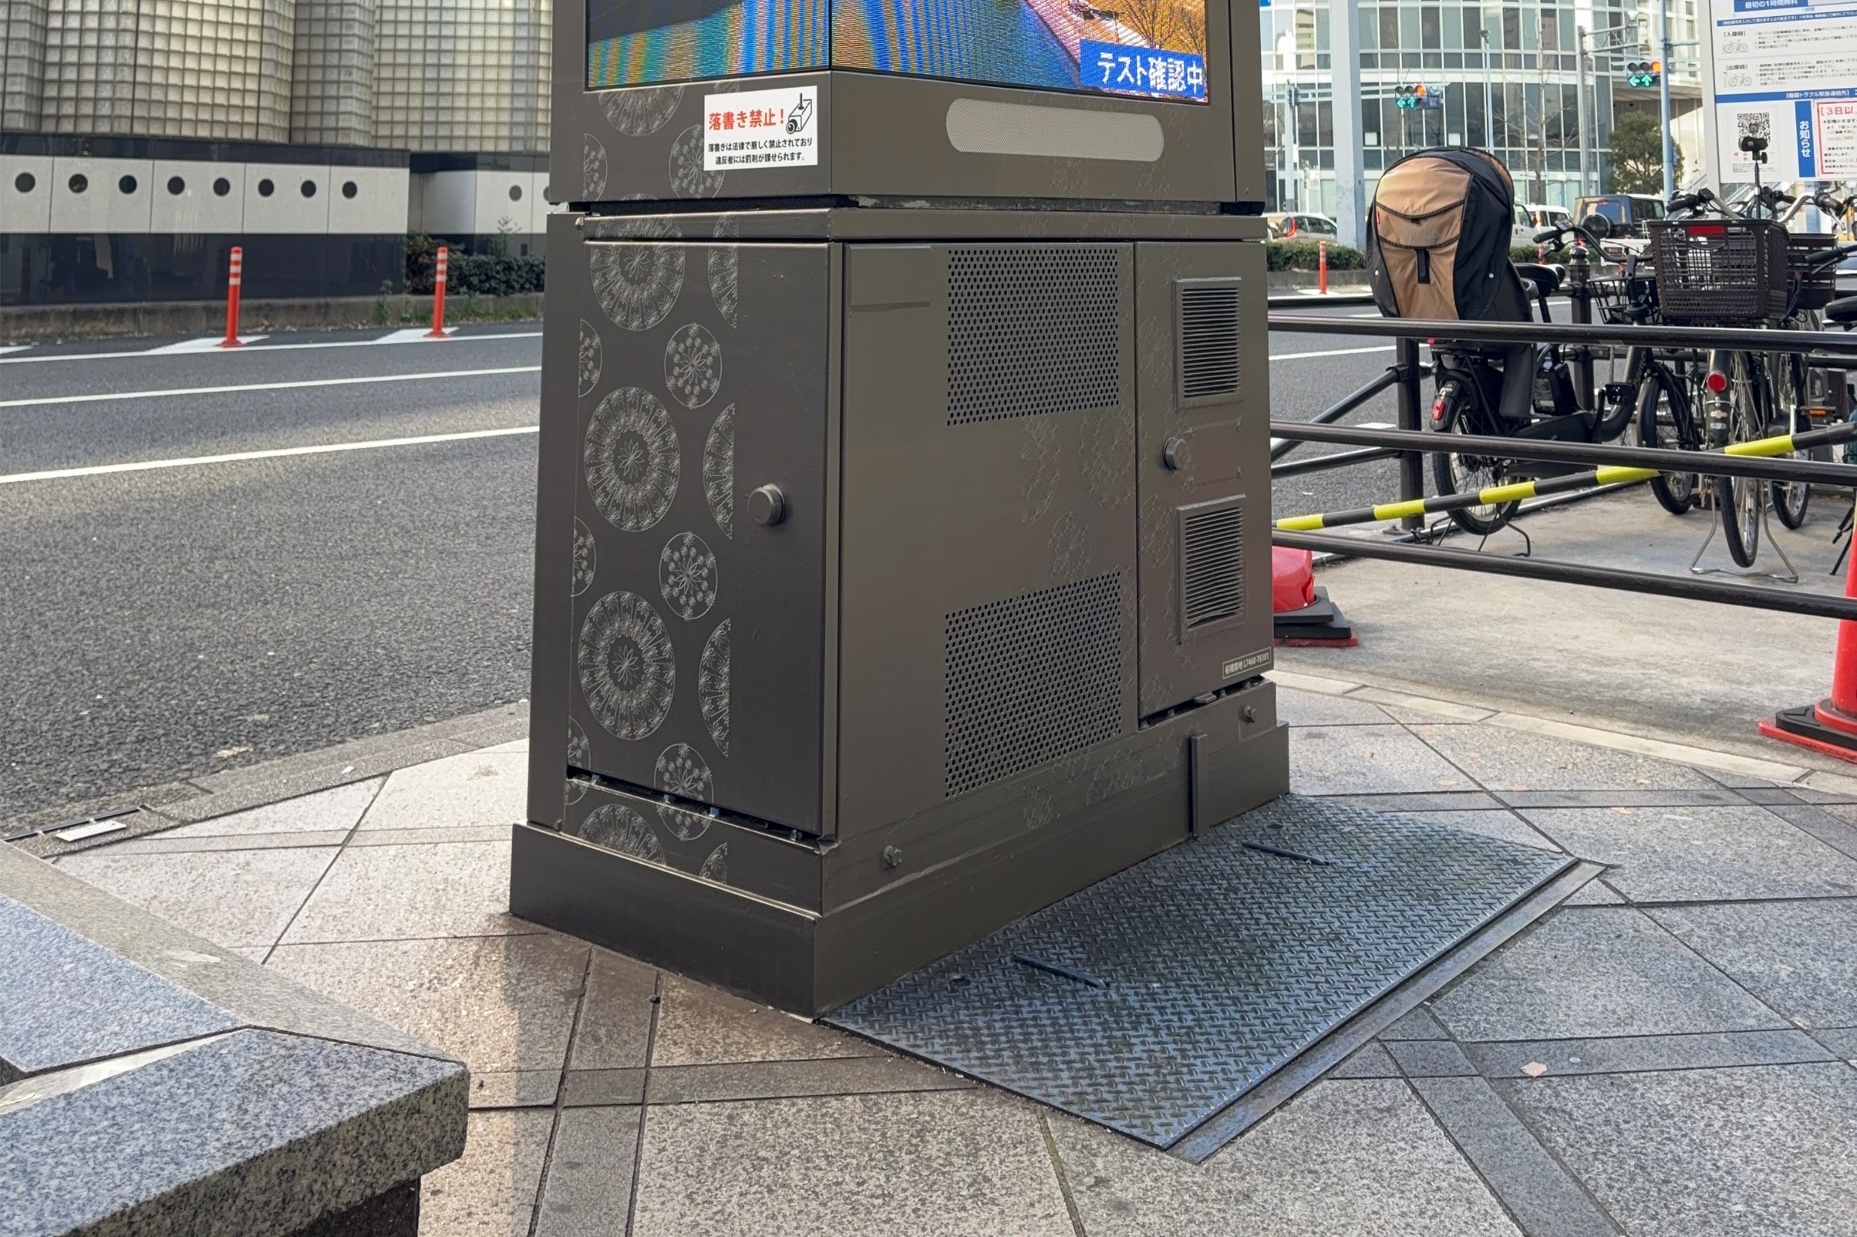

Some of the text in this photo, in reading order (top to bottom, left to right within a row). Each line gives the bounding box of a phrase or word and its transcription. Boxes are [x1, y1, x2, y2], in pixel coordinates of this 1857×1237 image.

[1097, 52, 1203, 95] テスト確認中
[1799, 120, 1811, 158] お知らせ
